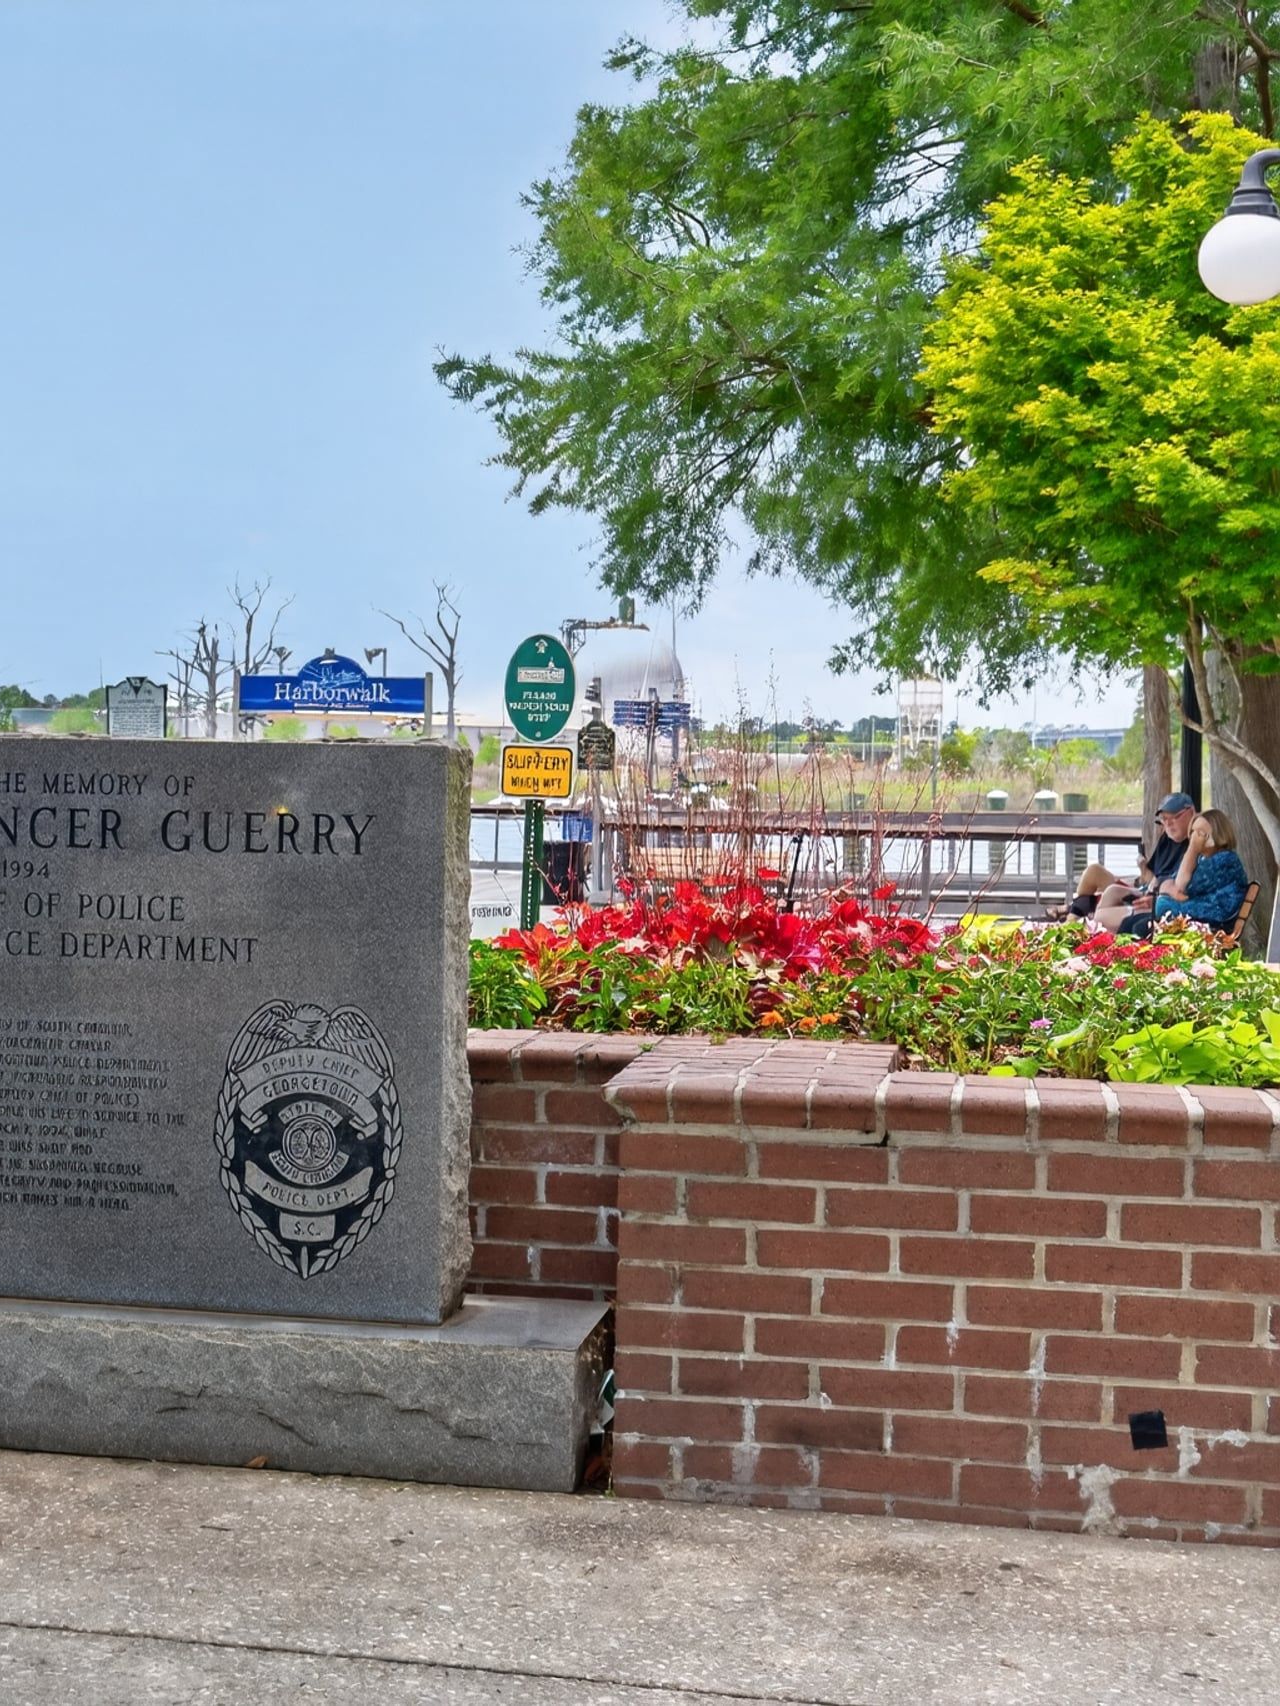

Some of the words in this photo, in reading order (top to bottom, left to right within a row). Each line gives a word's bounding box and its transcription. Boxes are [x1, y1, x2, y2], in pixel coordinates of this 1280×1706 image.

[274, 682, 392, 704] Harborwalk
[506, 752, 569, 770] SLIPPERY
[42, 773, 150, 797] MEMORY
[164, 775, 195, 797] OF
[160, 810, 377, 857] GUERRY
[1, 861, 50, 879] 1994
[22, 892, 62, 918] OF
[77, 893, 186, 922] POLICE
[59, 930, 259, 963] DEPARTMENT
[263, 1054, 315, 1074] DEPUTY
[323, 1057, 360, 1079] CHIEF
[263, 1076, 359, 1106] GEORGETOWN
[262, 1181, 309, 1206] POLICE
[317, 1187, 355, 1206] DEPT.
